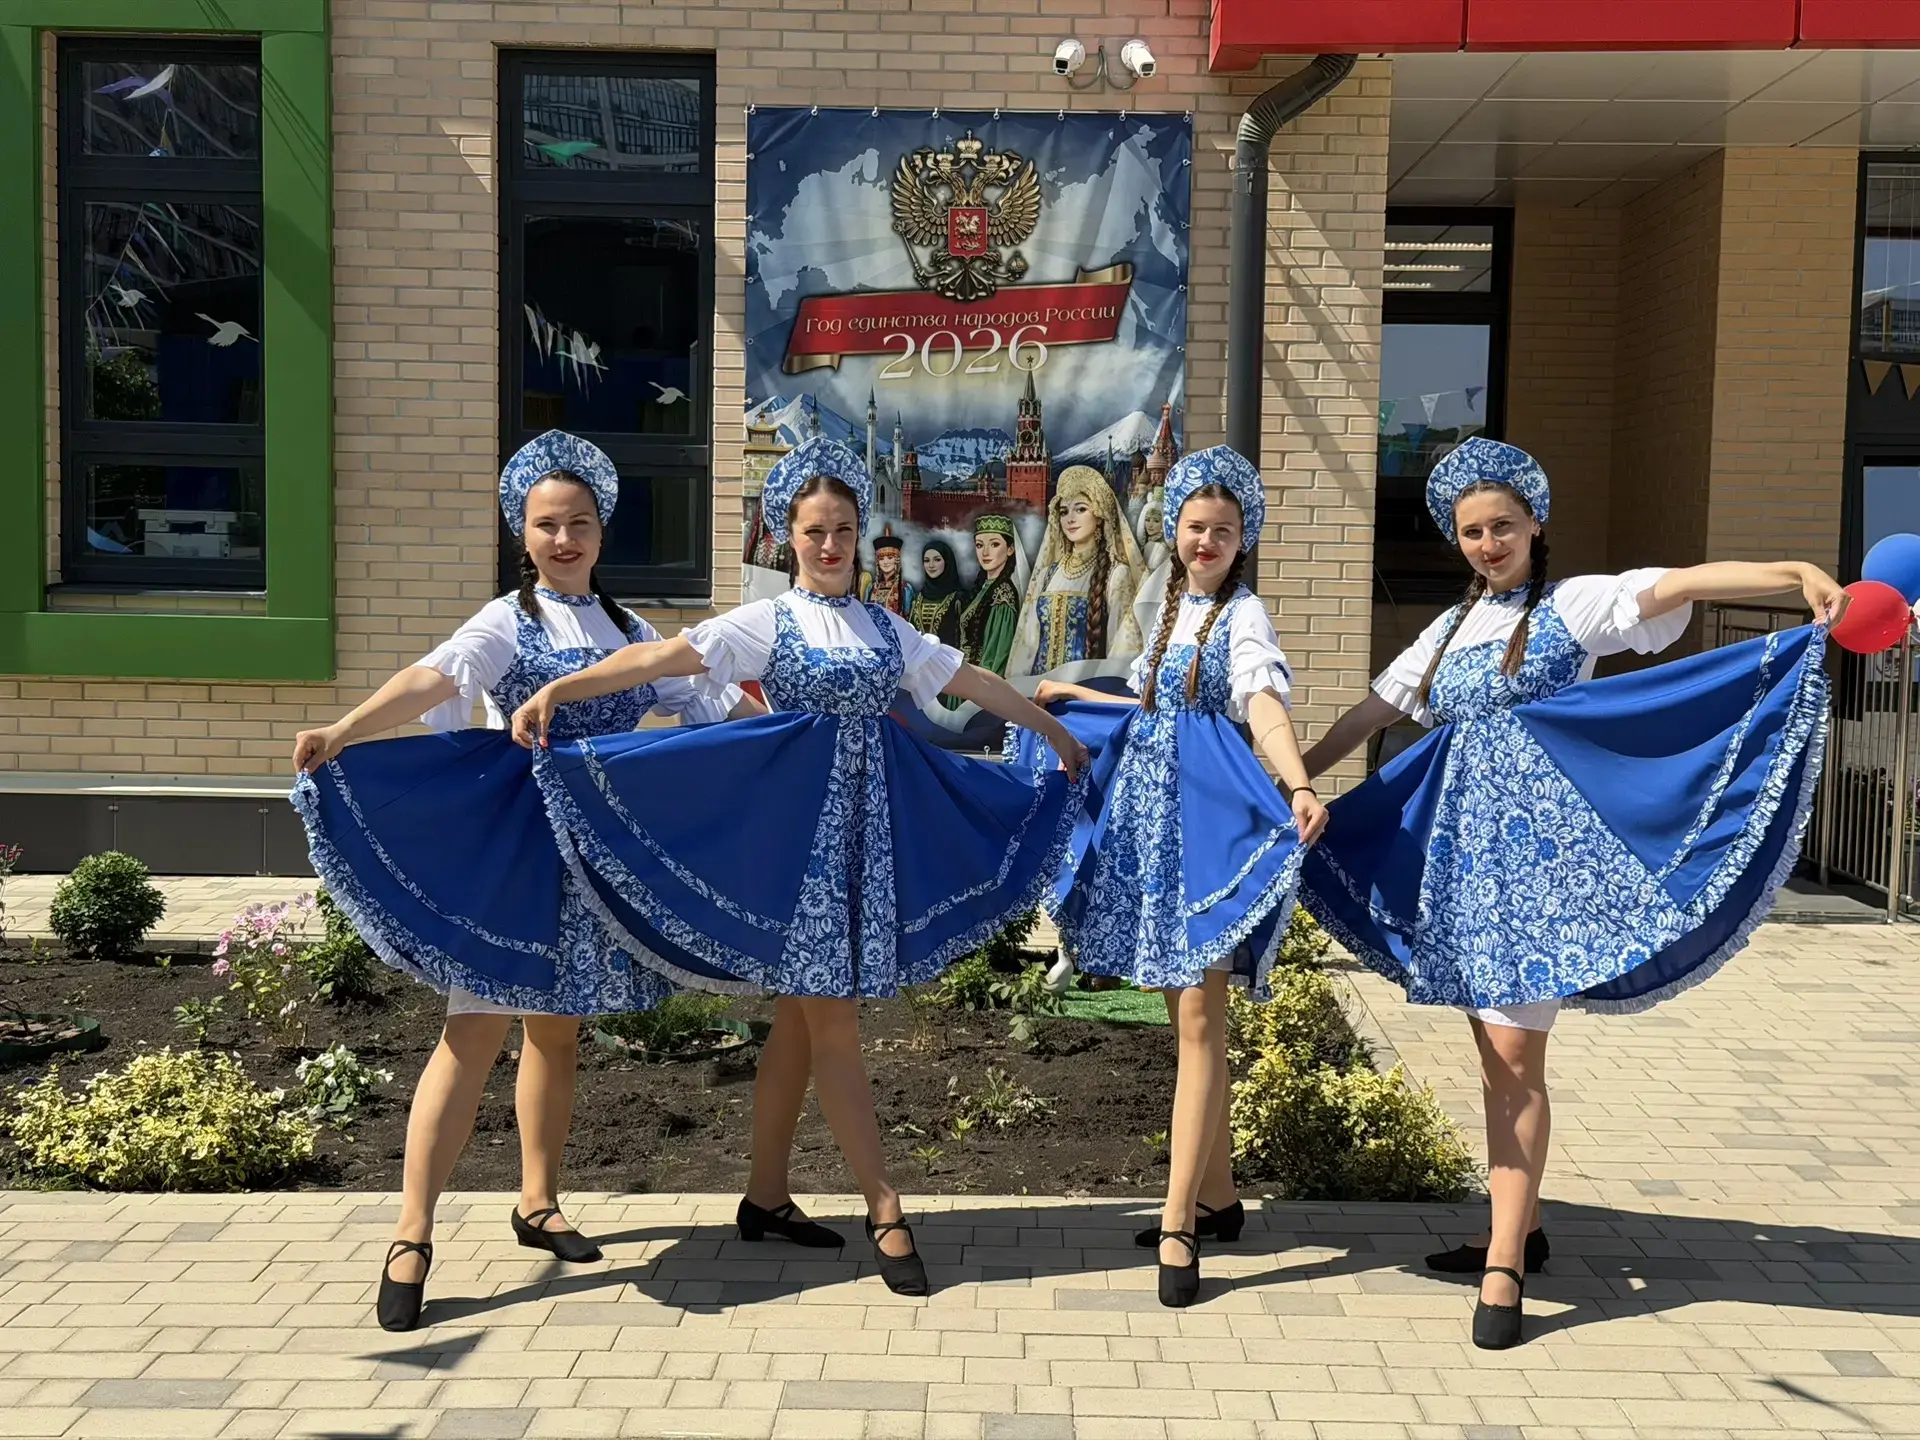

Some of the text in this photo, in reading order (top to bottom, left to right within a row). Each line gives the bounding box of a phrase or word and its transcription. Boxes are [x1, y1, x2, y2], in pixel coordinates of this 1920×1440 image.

[806, 305, 1116, 335] Год единства народов России
[879, 325, 1048, 380] 2026
